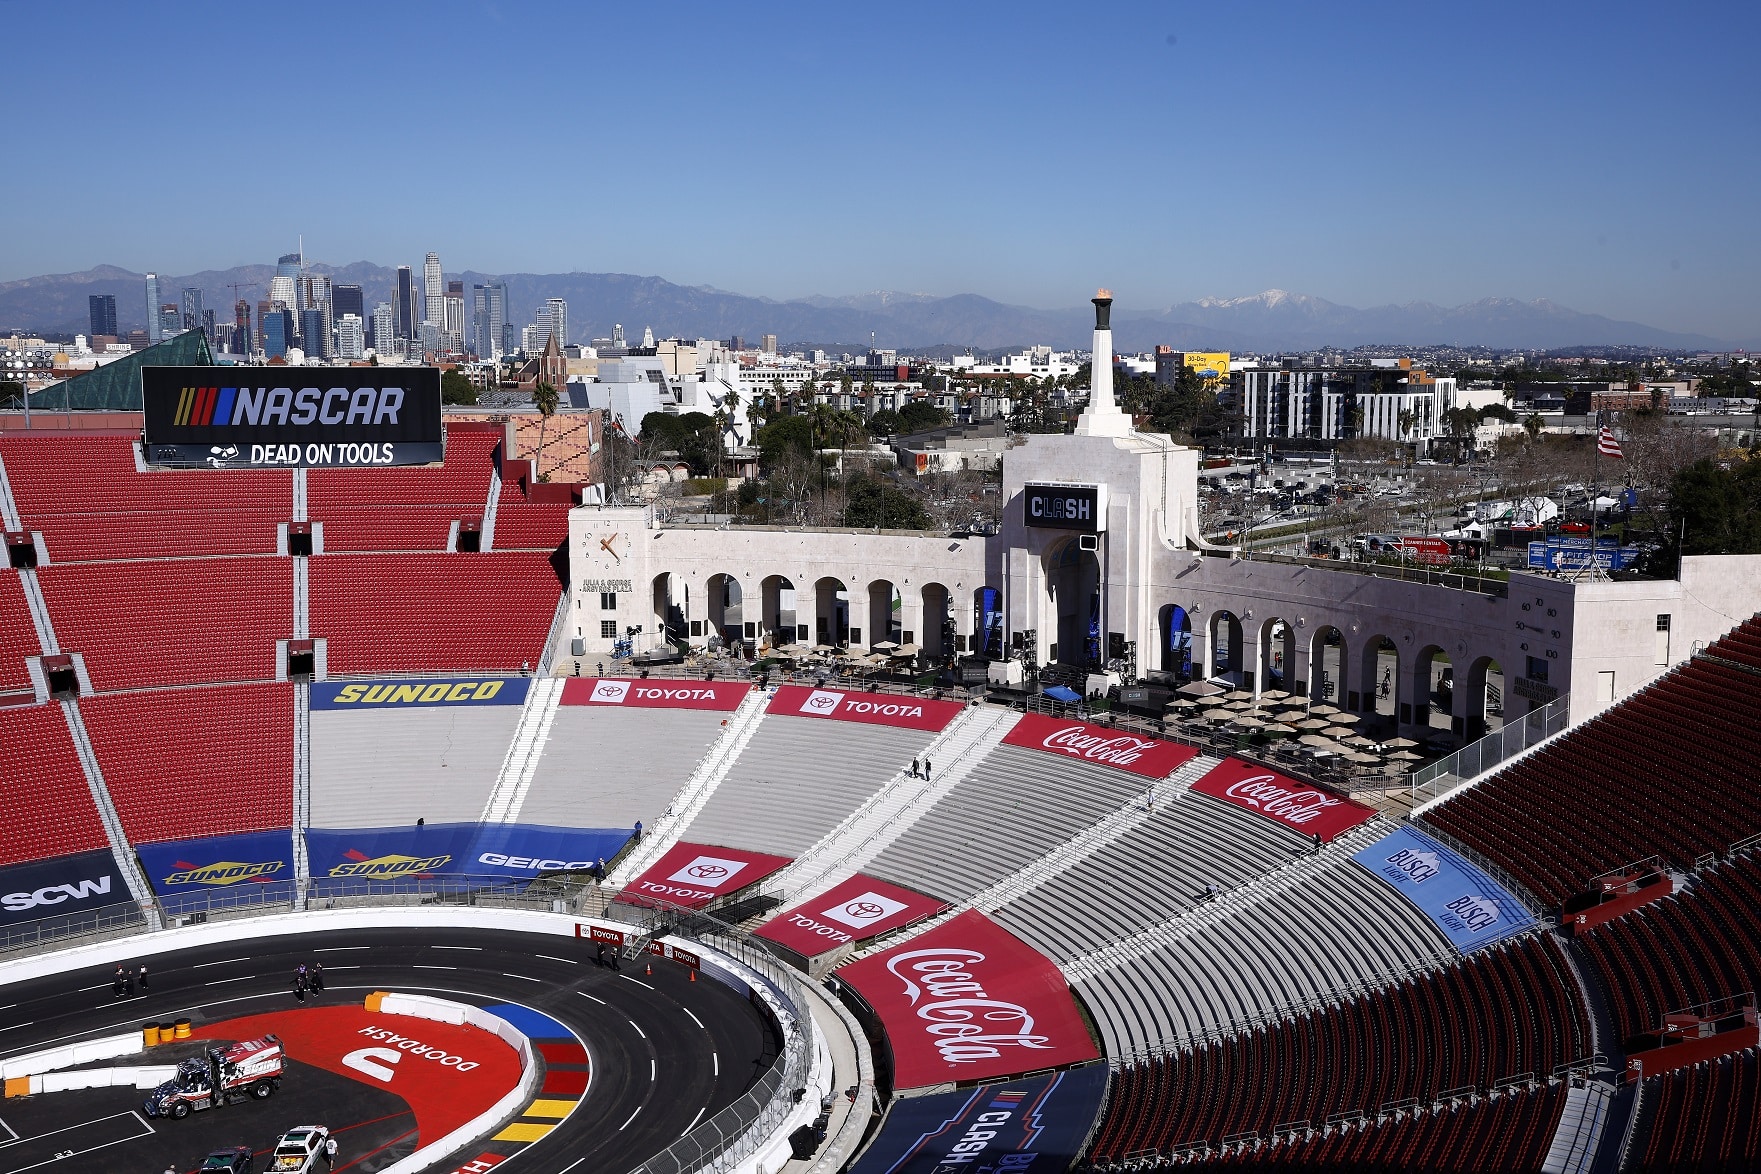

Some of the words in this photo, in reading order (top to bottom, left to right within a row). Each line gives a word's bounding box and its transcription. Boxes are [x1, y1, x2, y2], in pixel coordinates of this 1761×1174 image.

[232, 387, 405, 425] NASCAR
[251, 444, 301, 464] DEAD
[304, 444, 331, 464] ON
[337, 443, 394, 463] TOOLS
[917, 454, 940, 465] CAAM
[1031, 496, 1090, 520] CLASH
[1521, 603, 1531, 612] 60
[1535, 598, 1544, 607] 70
[1515, 621, 1525, 630] 50
[1551, 630, 1561, 639] 90
[1545, 649, 1558, 659] 100
[333, 681, 504, 703] SUNOCO
[635, 688, 716, 700] TOYOTA
[846, 700, 922, 718] TOYOTA
[1042, 726, 1162, 766] Coca-Cola
[1226, 775, 1344, 825] Coca-Cola
[338, 855, 446, 876] SUNOCO
[479, 852, 595, 871] GEICO
[1387, 849, 1439, 884] BUSCH
[168, 862, 282, 884] SUNOCO
[1382, 866, 1410, 883] LIGHT
[1, 876, 111, 911] SCW
[639, 881, 716, 900] TOYOTA
[1439, 913, 1466, 932] LIGHT
[1446, 895, 1498, 932] BUSCH
[592, 929, 620, 942] TOYOTA
[788, 914, 853, 943] TOYOTA
[674, 951, 697, 965] TOYOTA
[886, 948, 1057, 1067] Coca-Cola
[358, 1025, 481, 1072] DOORDASH
[939, 1111, 1012, 1164] CLASH
